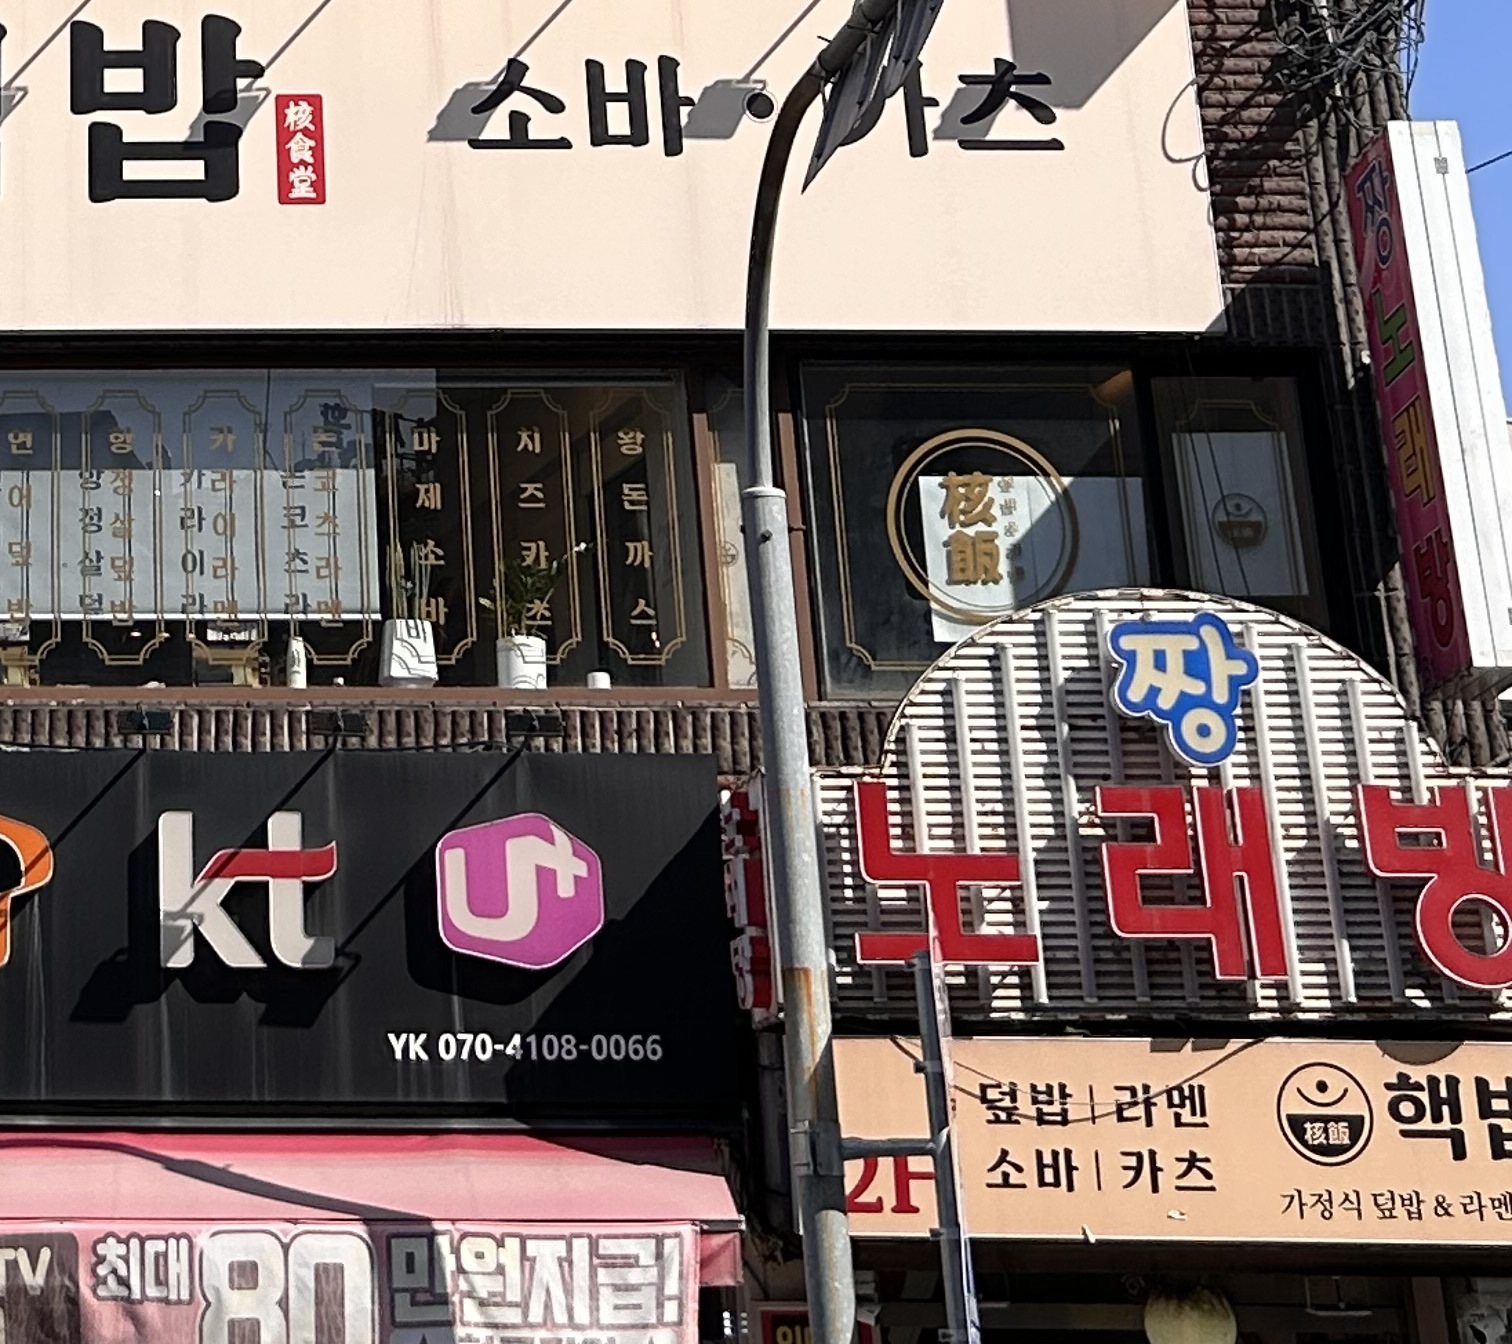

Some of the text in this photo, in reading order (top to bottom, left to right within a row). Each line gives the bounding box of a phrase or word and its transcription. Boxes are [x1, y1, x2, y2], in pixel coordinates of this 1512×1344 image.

[284, 99, 319, 200] 核食堂
[467, 54, 696, 157] 소바
[616, 427, 657, 626] 왕돈까스
[1114, 616, 1255, 761] 짱
[157, 810, 338, 970] kt
[854, 780, 1512, 990] 노래방
[387, 1032, 664, 1062] YK 070-4108-0066
[978, 1081, 1211, 1130] 덮밥 라멘
[986, 1147, 1218, 1194] 소바 카츠
[1280, 1188, 1363, 1221] 가정식
[1370, 1189, 1426, 1221] 덮밥
[1433, 1194, 1455, 1218] &
[95, 1235, 192, 1301] 최대
